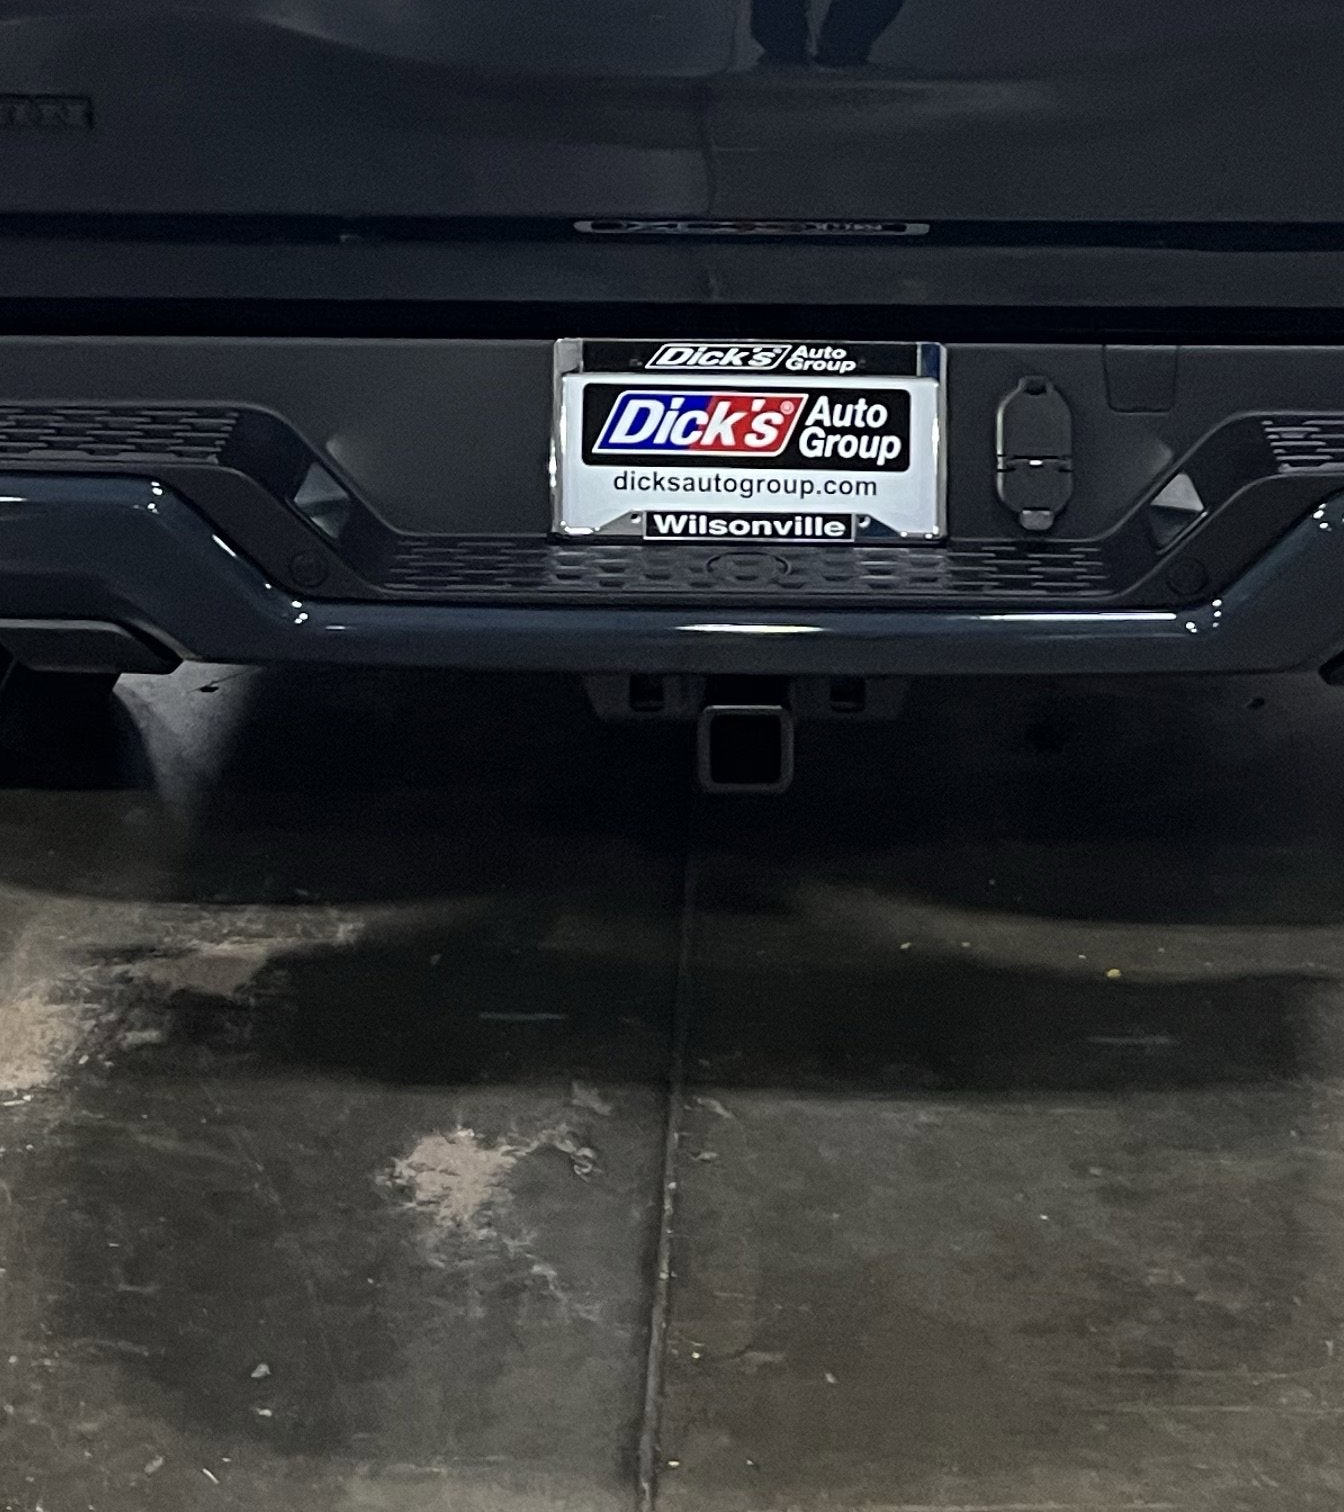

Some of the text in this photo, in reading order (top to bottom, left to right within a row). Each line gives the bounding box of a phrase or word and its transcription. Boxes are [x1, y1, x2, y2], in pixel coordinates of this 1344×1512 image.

[655, 346, 776, 367] Dick's
[785, 358, 856, 373] Group
[790, 345, 847, 360] Auto
[608, 397, 785, 449] Dick's
[804, 394, 888, 428] Auto
[798, 425, 902, 466] Group
[613, 470, 878, 499] dicksautogroup.com
[653, 513, 847, 537] Wilsonville
